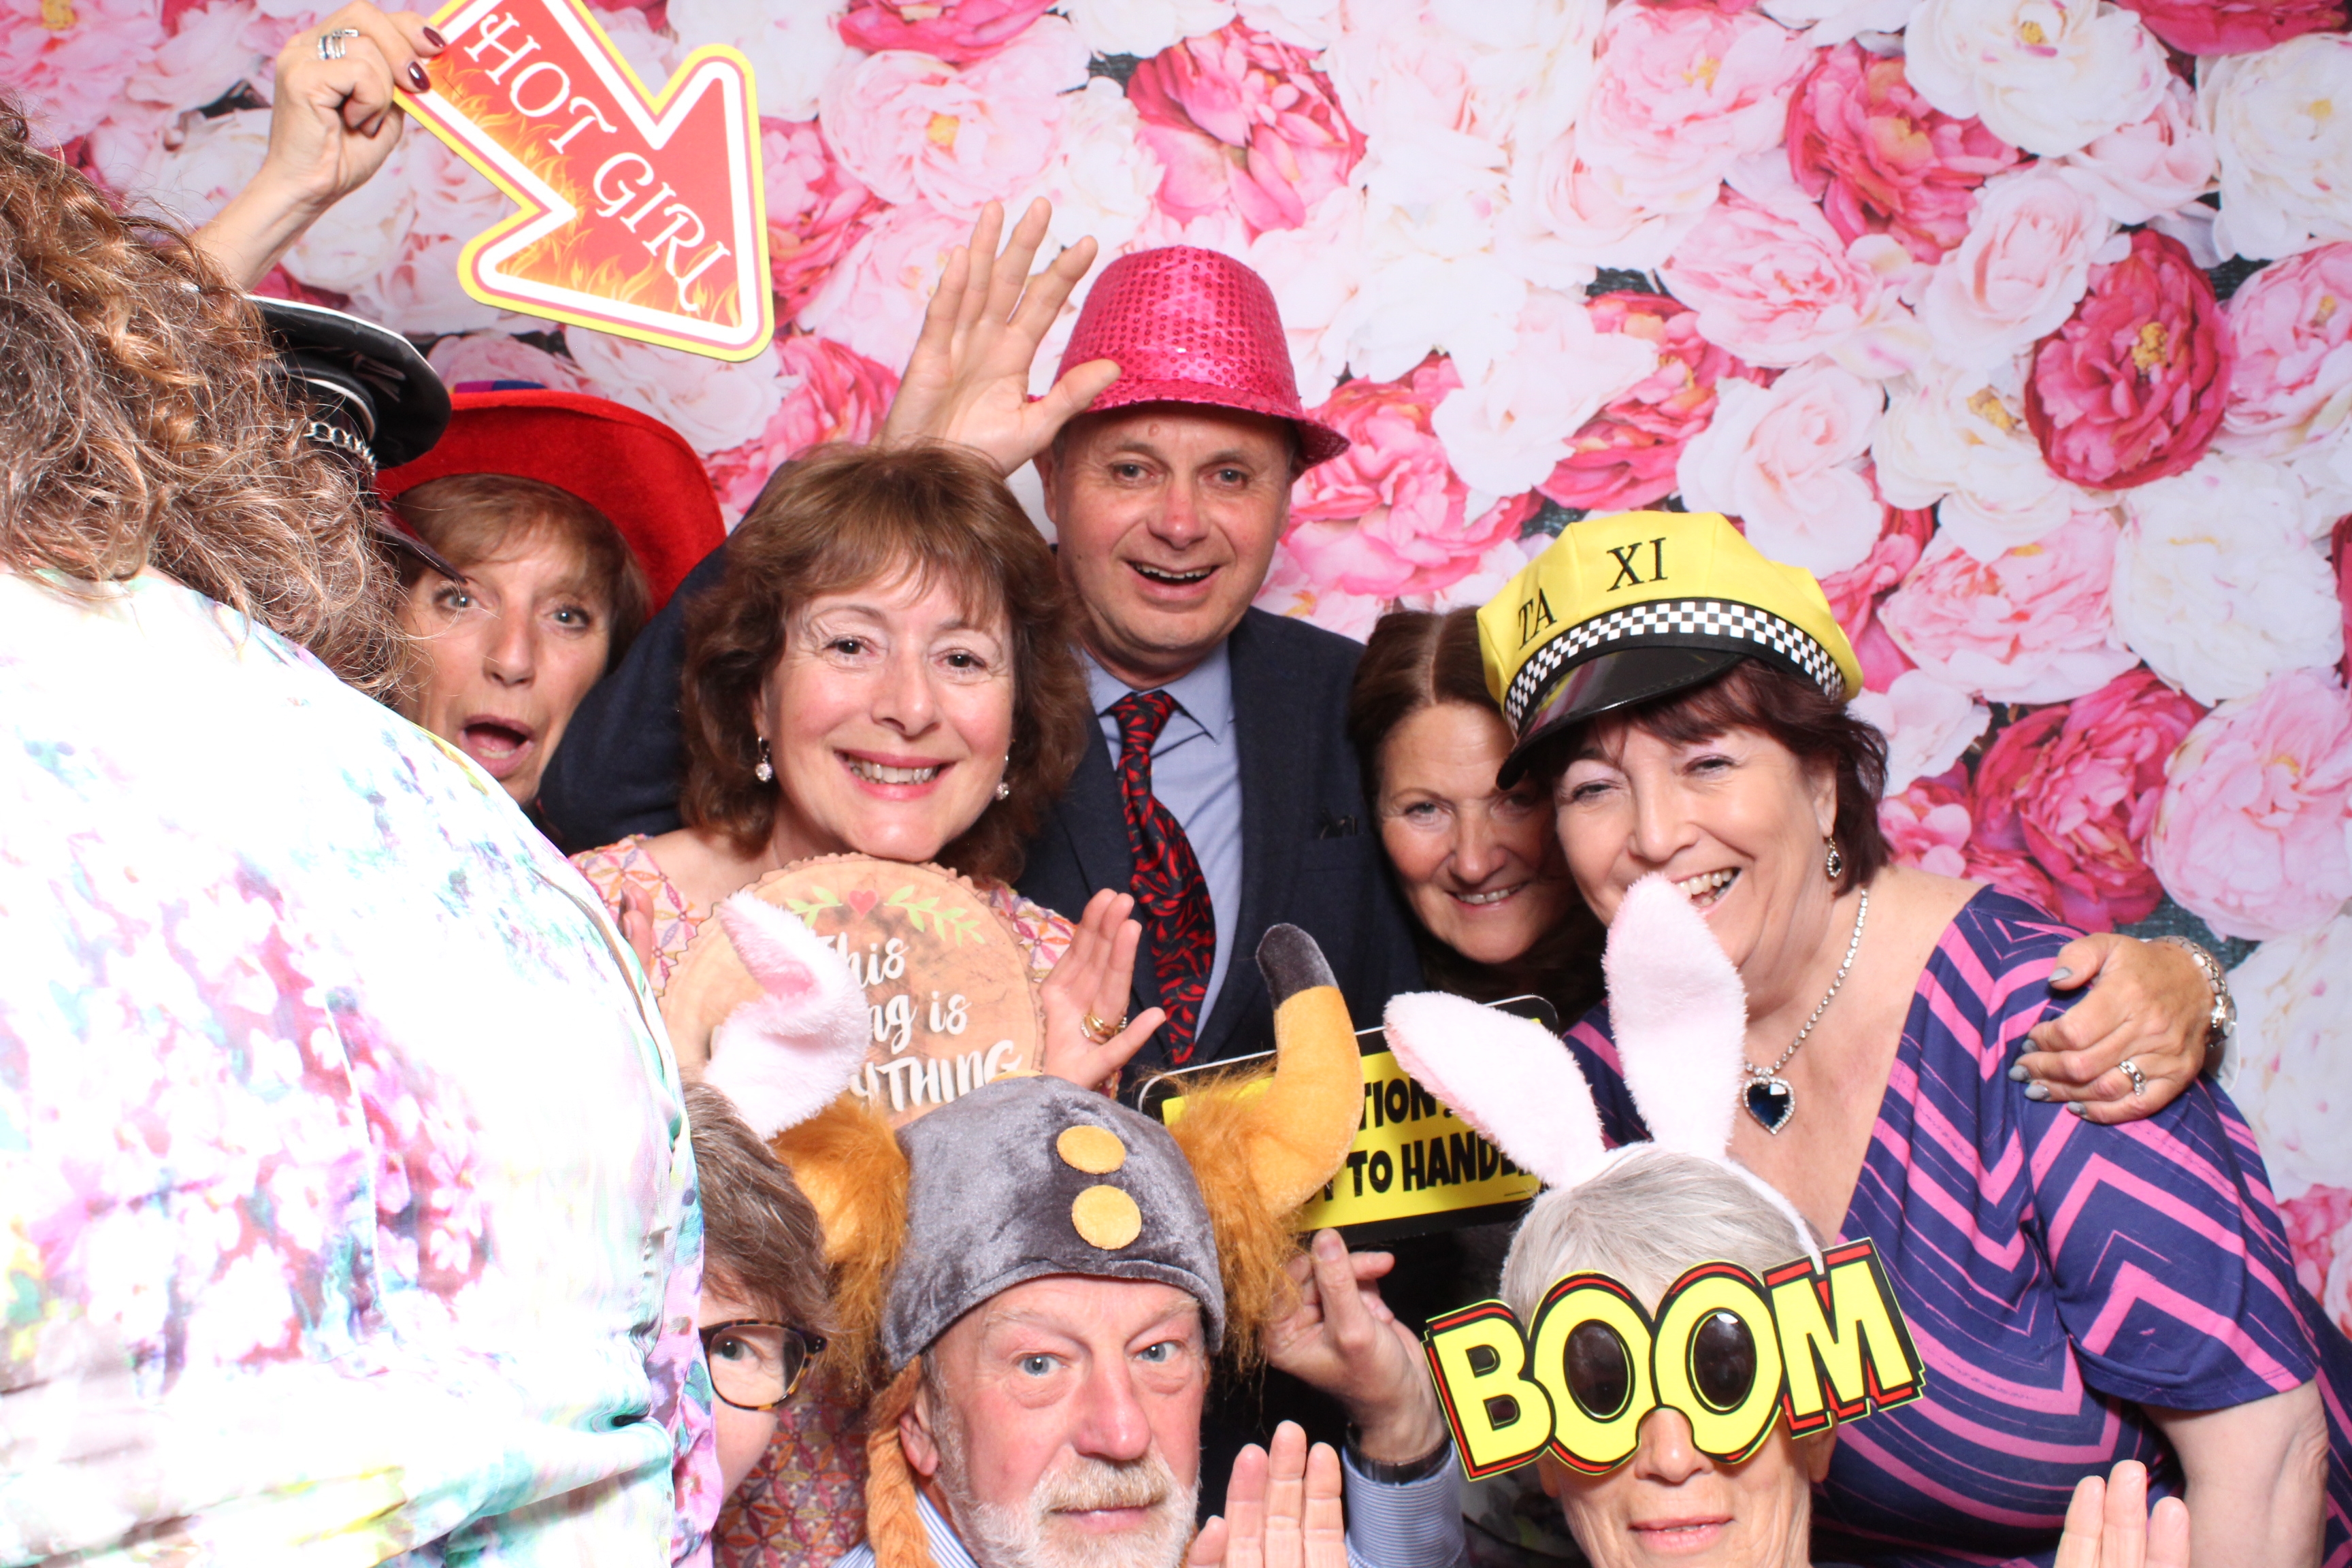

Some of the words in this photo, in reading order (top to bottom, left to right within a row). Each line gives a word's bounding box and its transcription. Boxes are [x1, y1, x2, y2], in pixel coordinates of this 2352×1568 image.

[463, 12, 617, 154] HOT
[592, 152, 731, 312] GIRL
[929, 991, 973, 1035] is
[849, 1039, 1023, 1112] YTHING
[1346, 1149, 1393, 1194] TO
[1401, 1130, 1532, 1192] HANDL
[1421, 1237, 1926, 1482] BOOM
